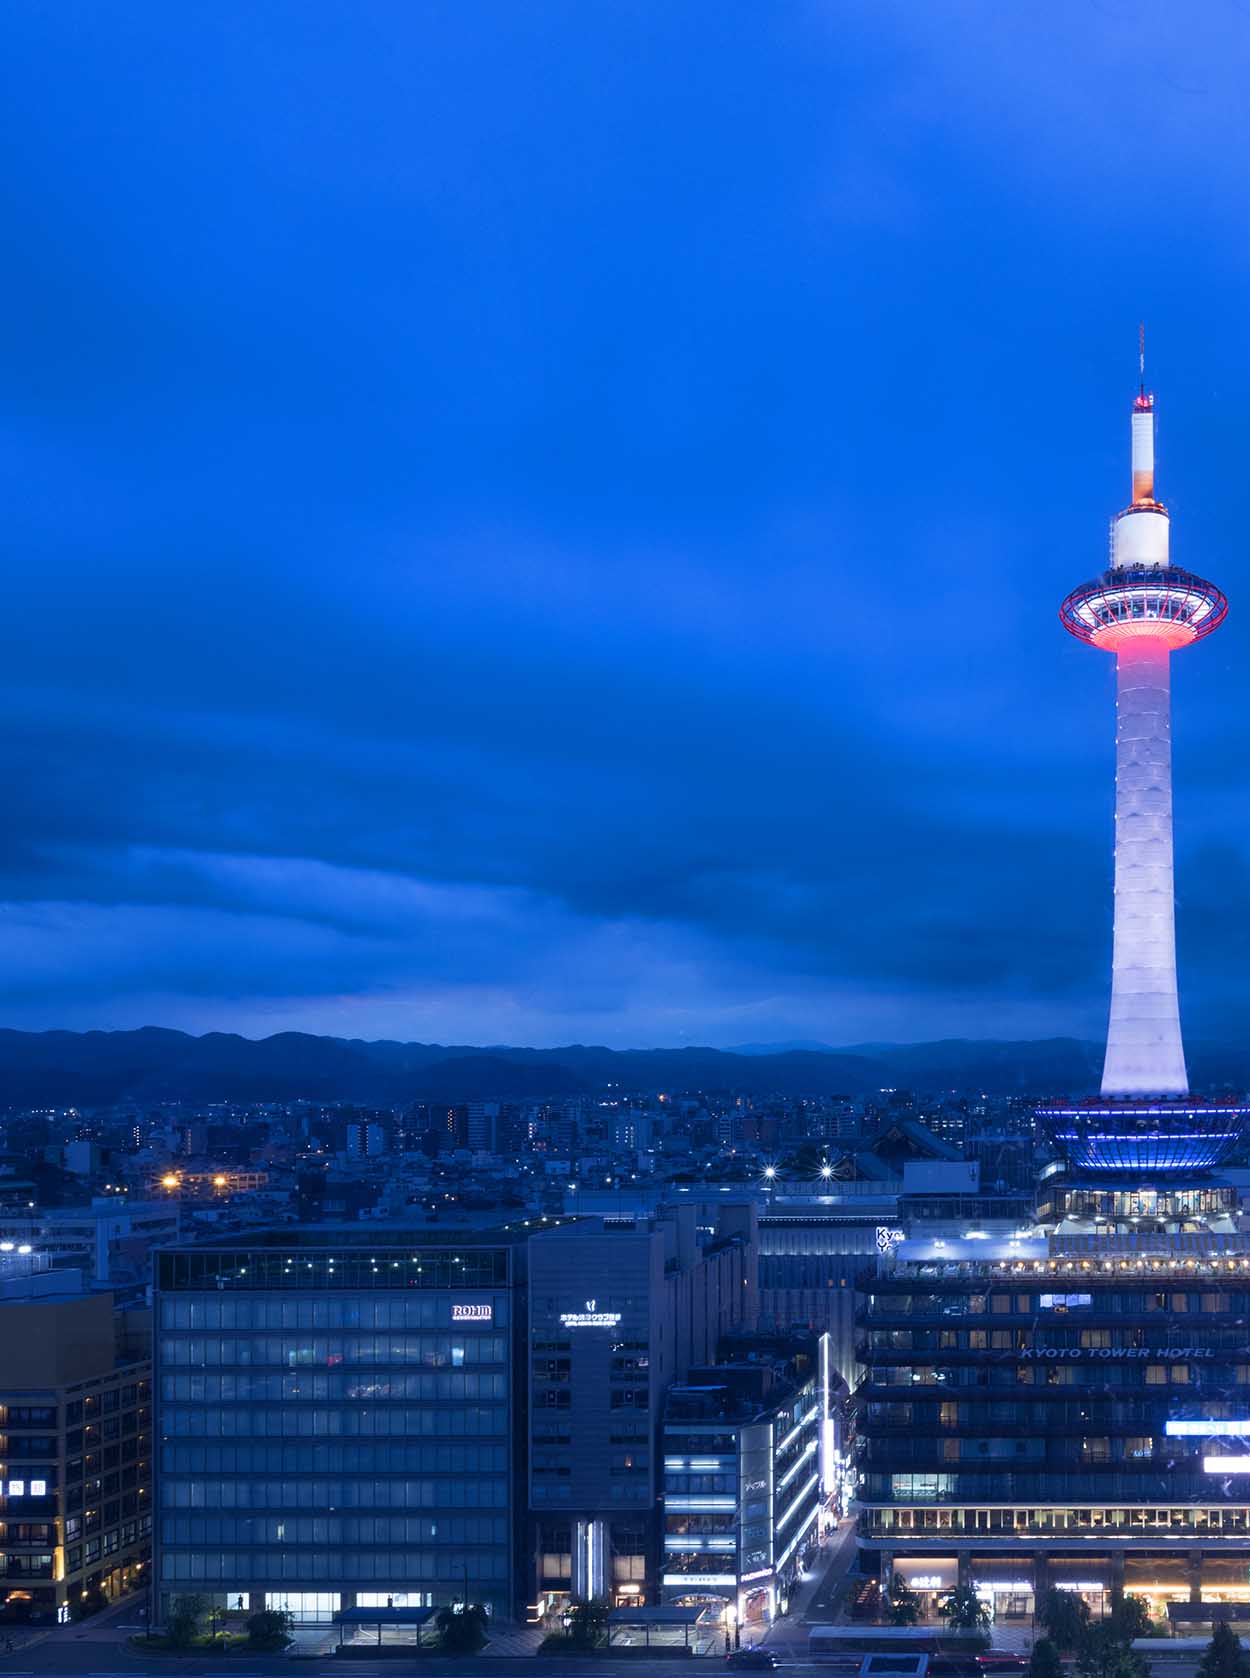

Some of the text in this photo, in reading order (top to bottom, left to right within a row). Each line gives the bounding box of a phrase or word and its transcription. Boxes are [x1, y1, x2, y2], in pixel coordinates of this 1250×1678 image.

[452, 1305, 492, 1316] ROHM
[1021, 1348, 1215, 1358] KYOTO TOWER HOTEL
